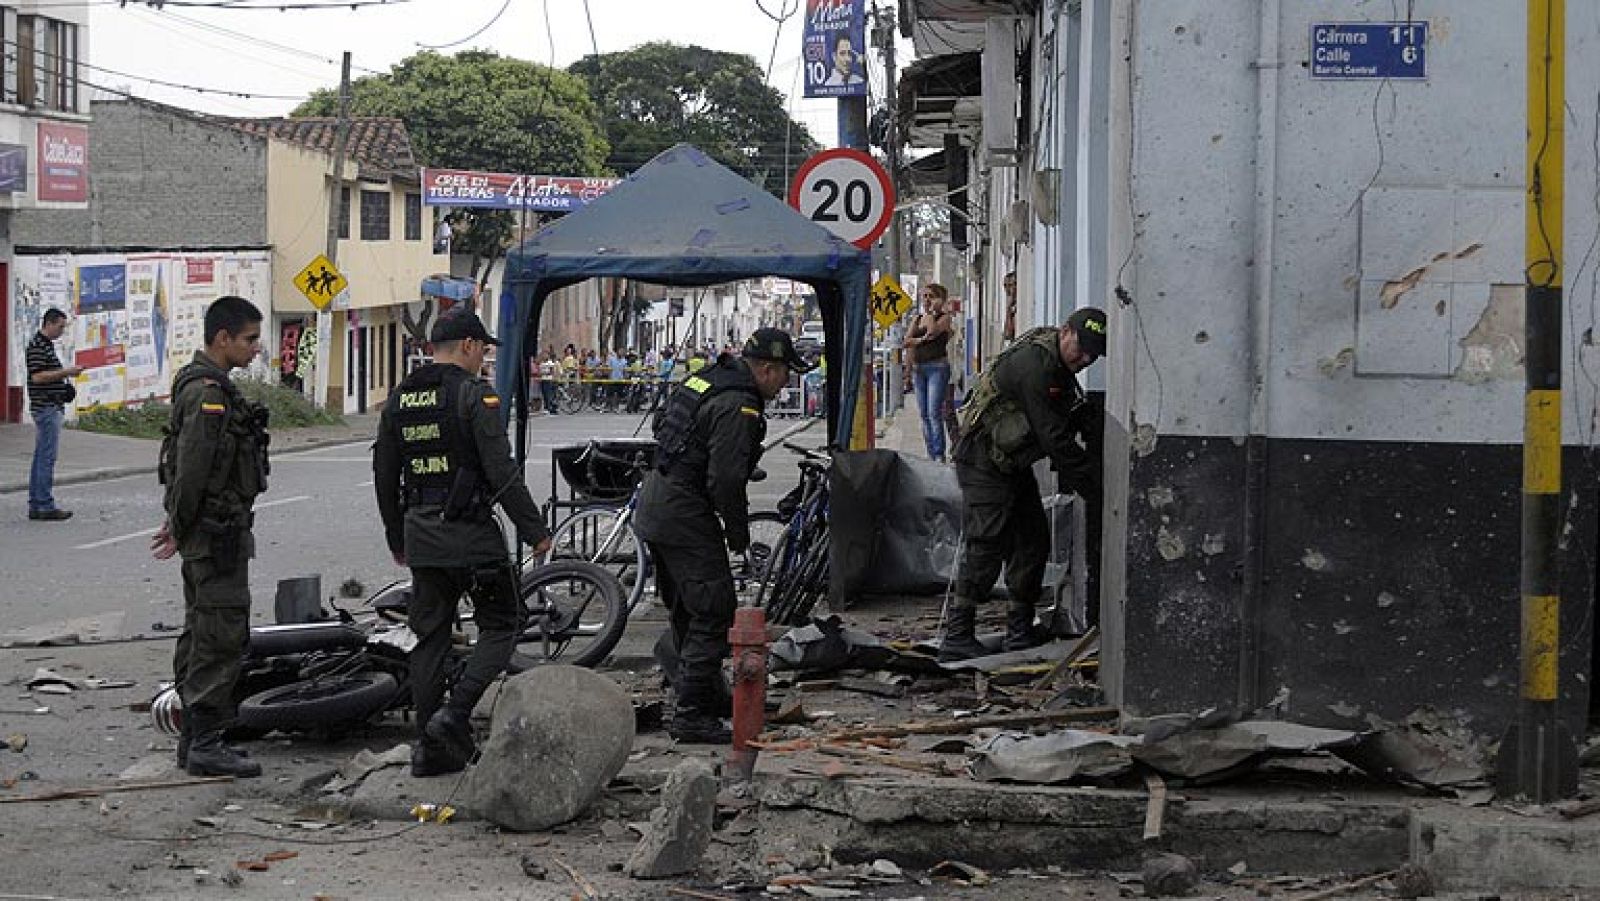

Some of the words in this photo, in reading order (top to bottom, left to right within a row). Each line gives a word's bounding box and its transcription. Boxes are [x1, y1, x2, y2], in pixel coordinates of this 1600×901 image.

[1389, 26, 1415, 44] 11
[1316, 47, 1351, 62] Calle
[1402, 46, 1418, 64] 6
[806, 61, 826, 85] 10
[1345, 65, 1377, 74] Central
[434, 174, 468, 185] CREE
[471, 176, 489, 186] EN
[430, 187, 454, 197] TUS
[457, 187, 495, 198] IDEAS
[507, 196, 570, 207] SENADOR
[812, 179, 871, 222] 20
